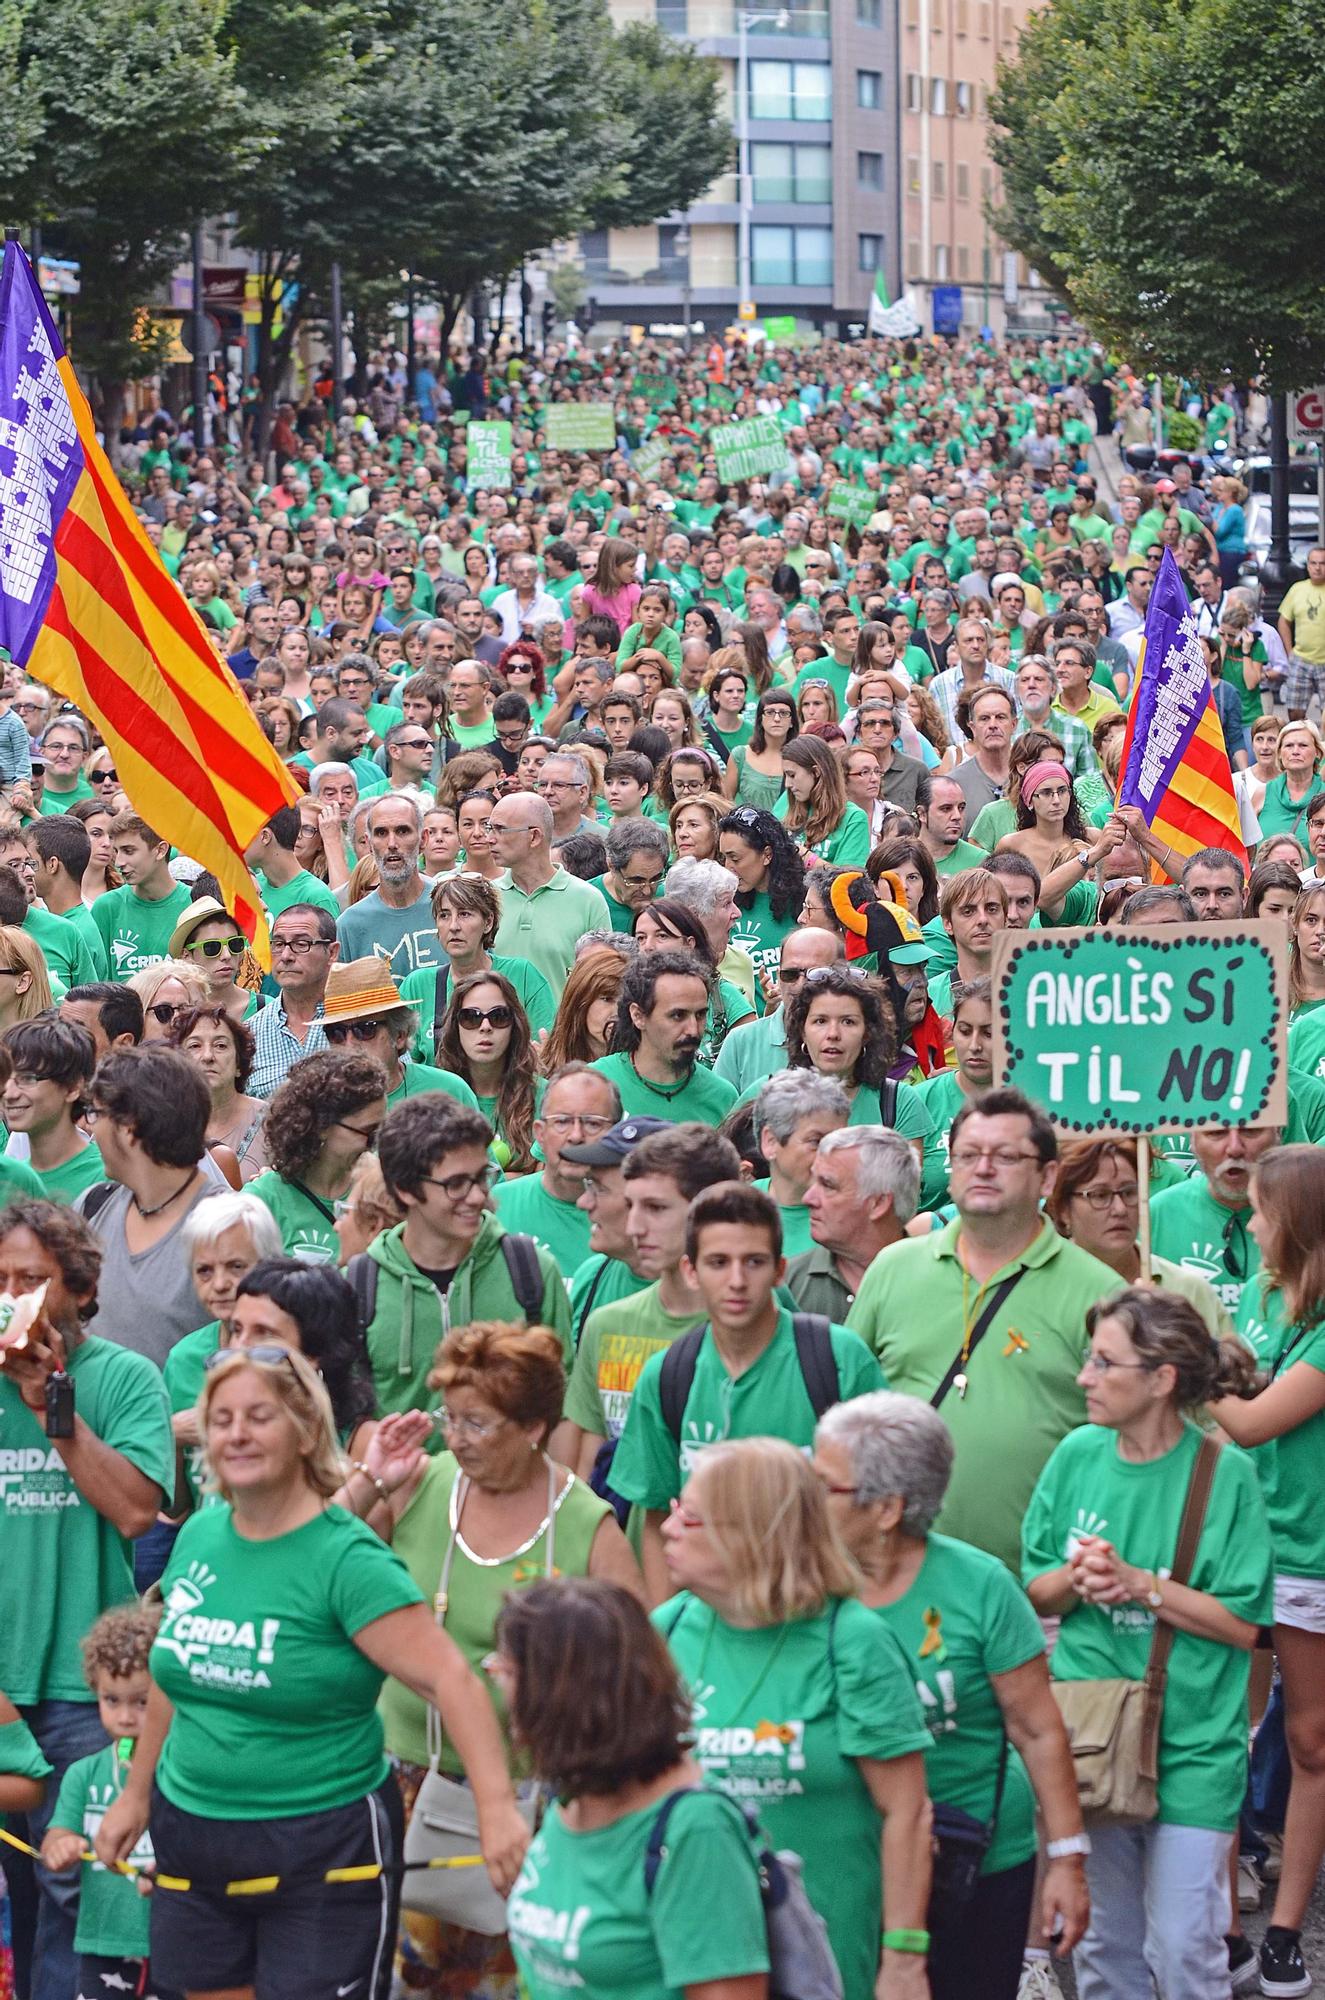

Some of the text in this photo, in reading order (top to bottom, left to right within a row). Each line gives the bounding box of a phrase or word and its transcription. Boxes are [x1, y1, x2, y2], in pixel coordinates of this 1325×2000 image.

[1026, 956, 1244, 1029] ANGLÈS SÍ
[1157, 1045, 1251, 1110] NO!
[6, 1488, 81, 1507] PÚBLICA
[173, 1613, 281, 1664] CRIDA!
[189, 1660, 272, 1689] PÚBLICA
